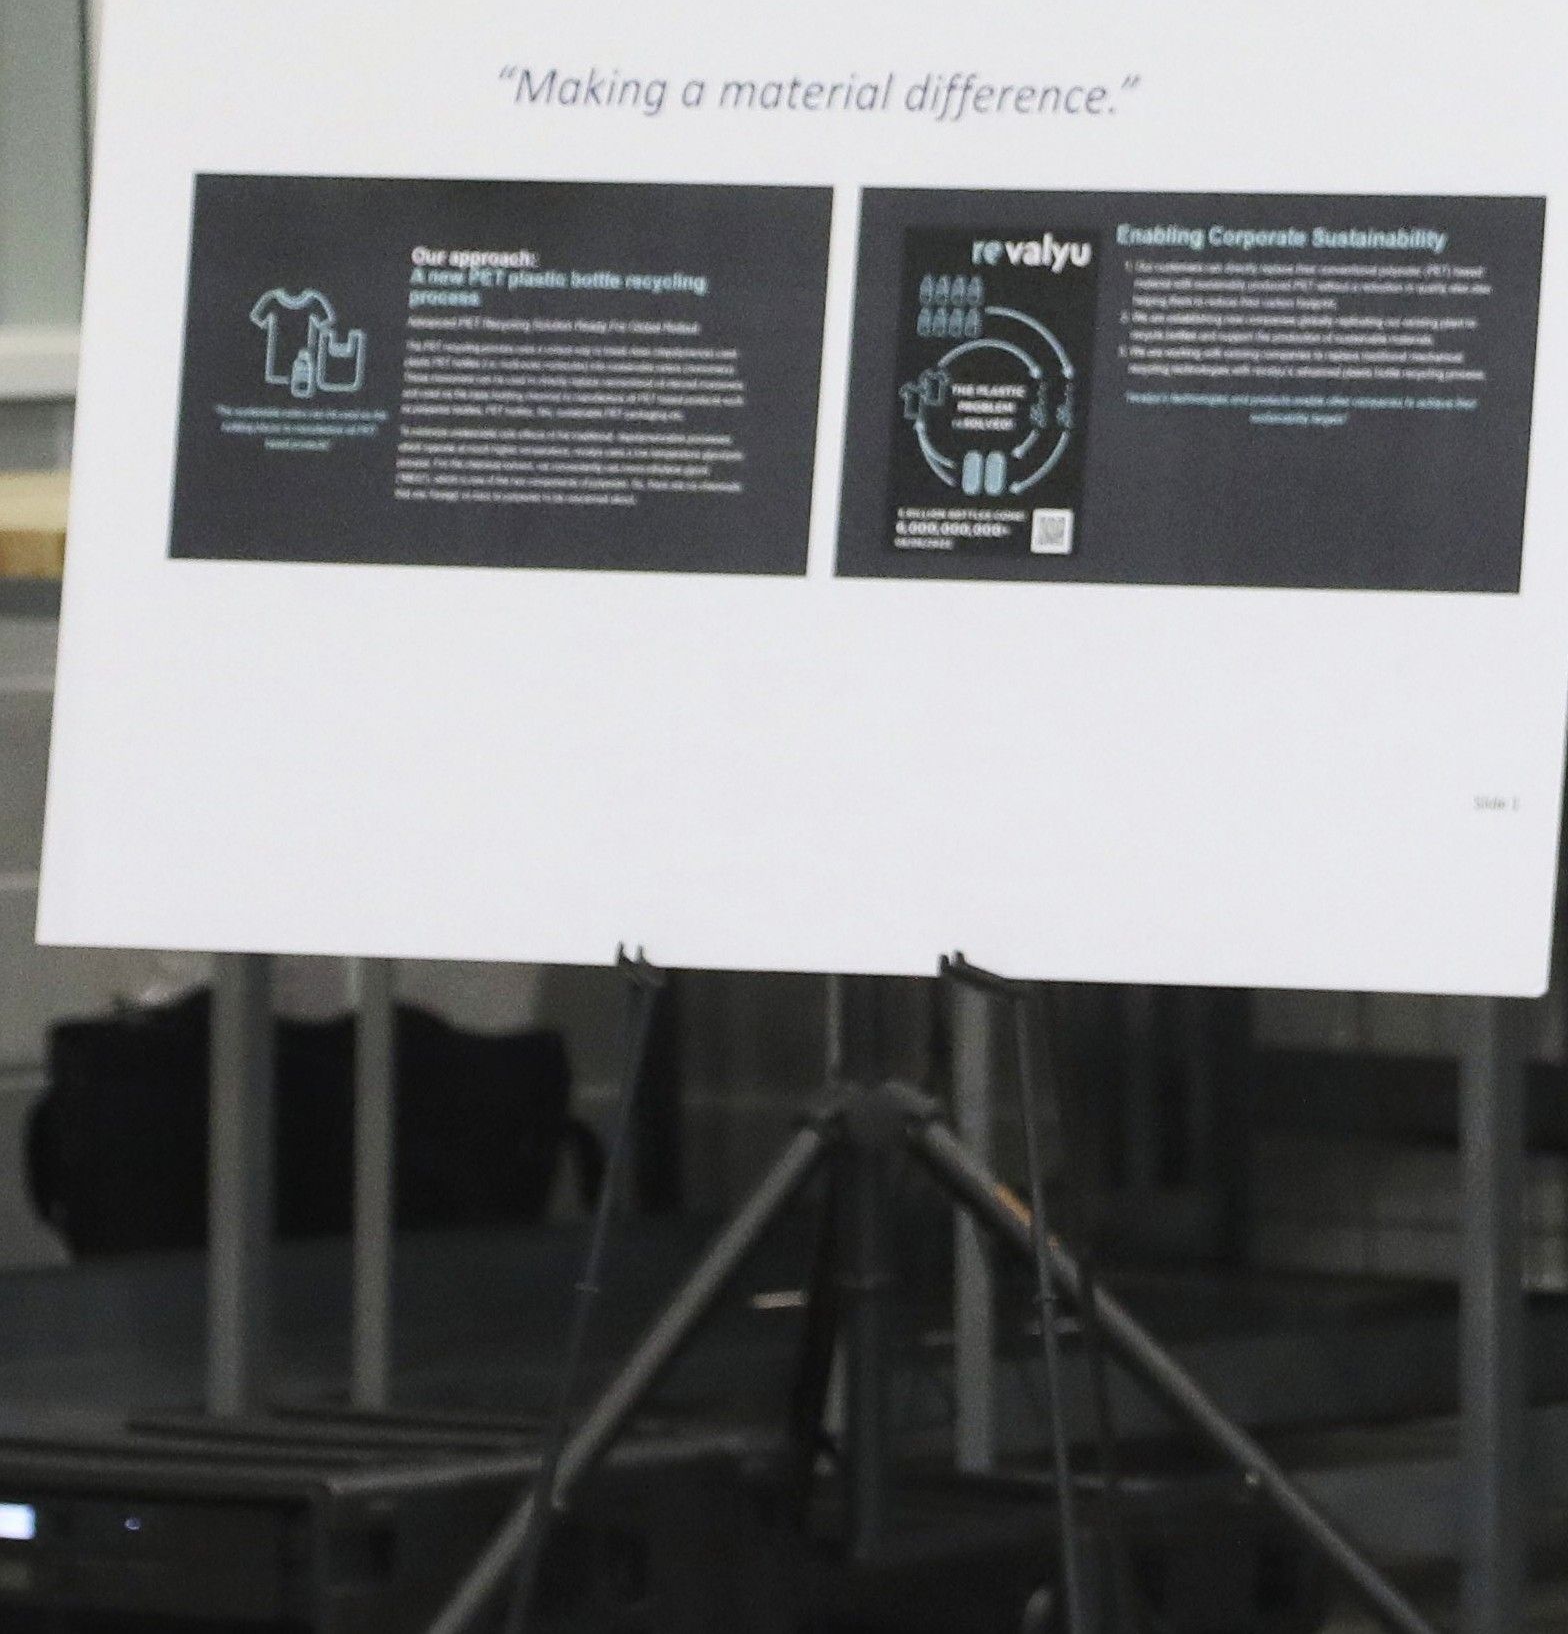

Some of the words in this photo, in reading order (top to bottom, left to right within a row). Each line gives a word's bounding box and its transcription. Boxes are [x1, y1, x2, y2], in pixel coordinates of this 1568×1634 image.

[682, 79, 705, 109] a
[719, 71, 894, 111] material
[1116, 223, 1205, 252] Enabling
[1208, 226, 1306, 250] Corporate
[1311, 227, 1447, 254] Sustainability
[411, 246, 447, 266] Our
[410, 267, 426, 284] A
[427, 270, 464, 285] new
[468, 267, 506, 286] PET
[508, 270, 568, 291] plastic
[570, 271, 624, 289] bottle
[625, 272, 707, 296] recycling
